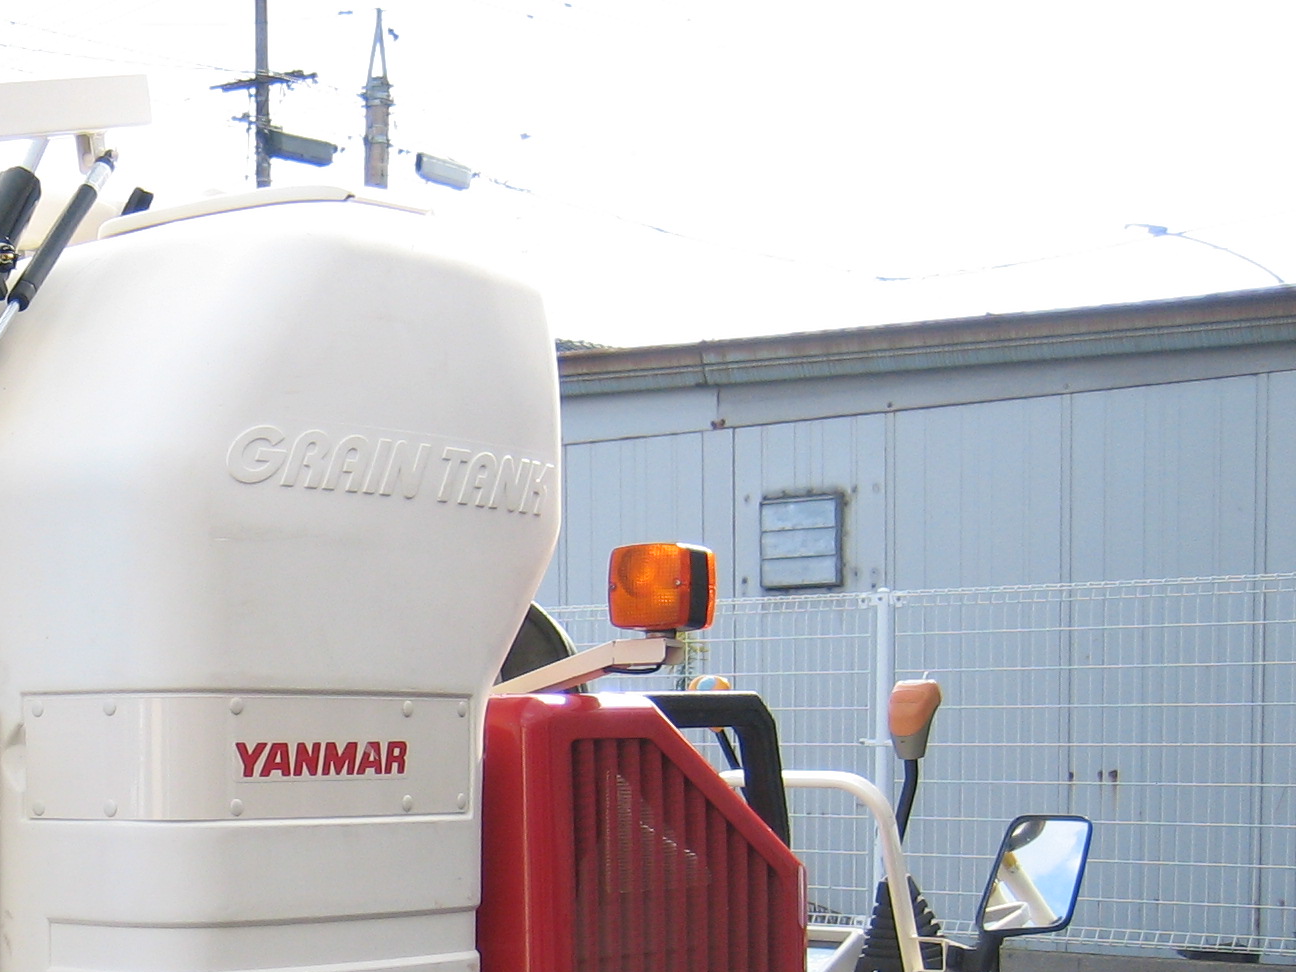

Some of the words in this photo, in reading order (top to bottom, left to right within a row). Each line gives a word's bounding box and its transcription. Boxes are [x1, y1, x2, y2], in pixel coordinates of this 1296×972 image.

[226, 425, 431, 500] GRAIN
[438, 446, 555, 516] TANK
[235, 741, 407, 777] YANMAR
